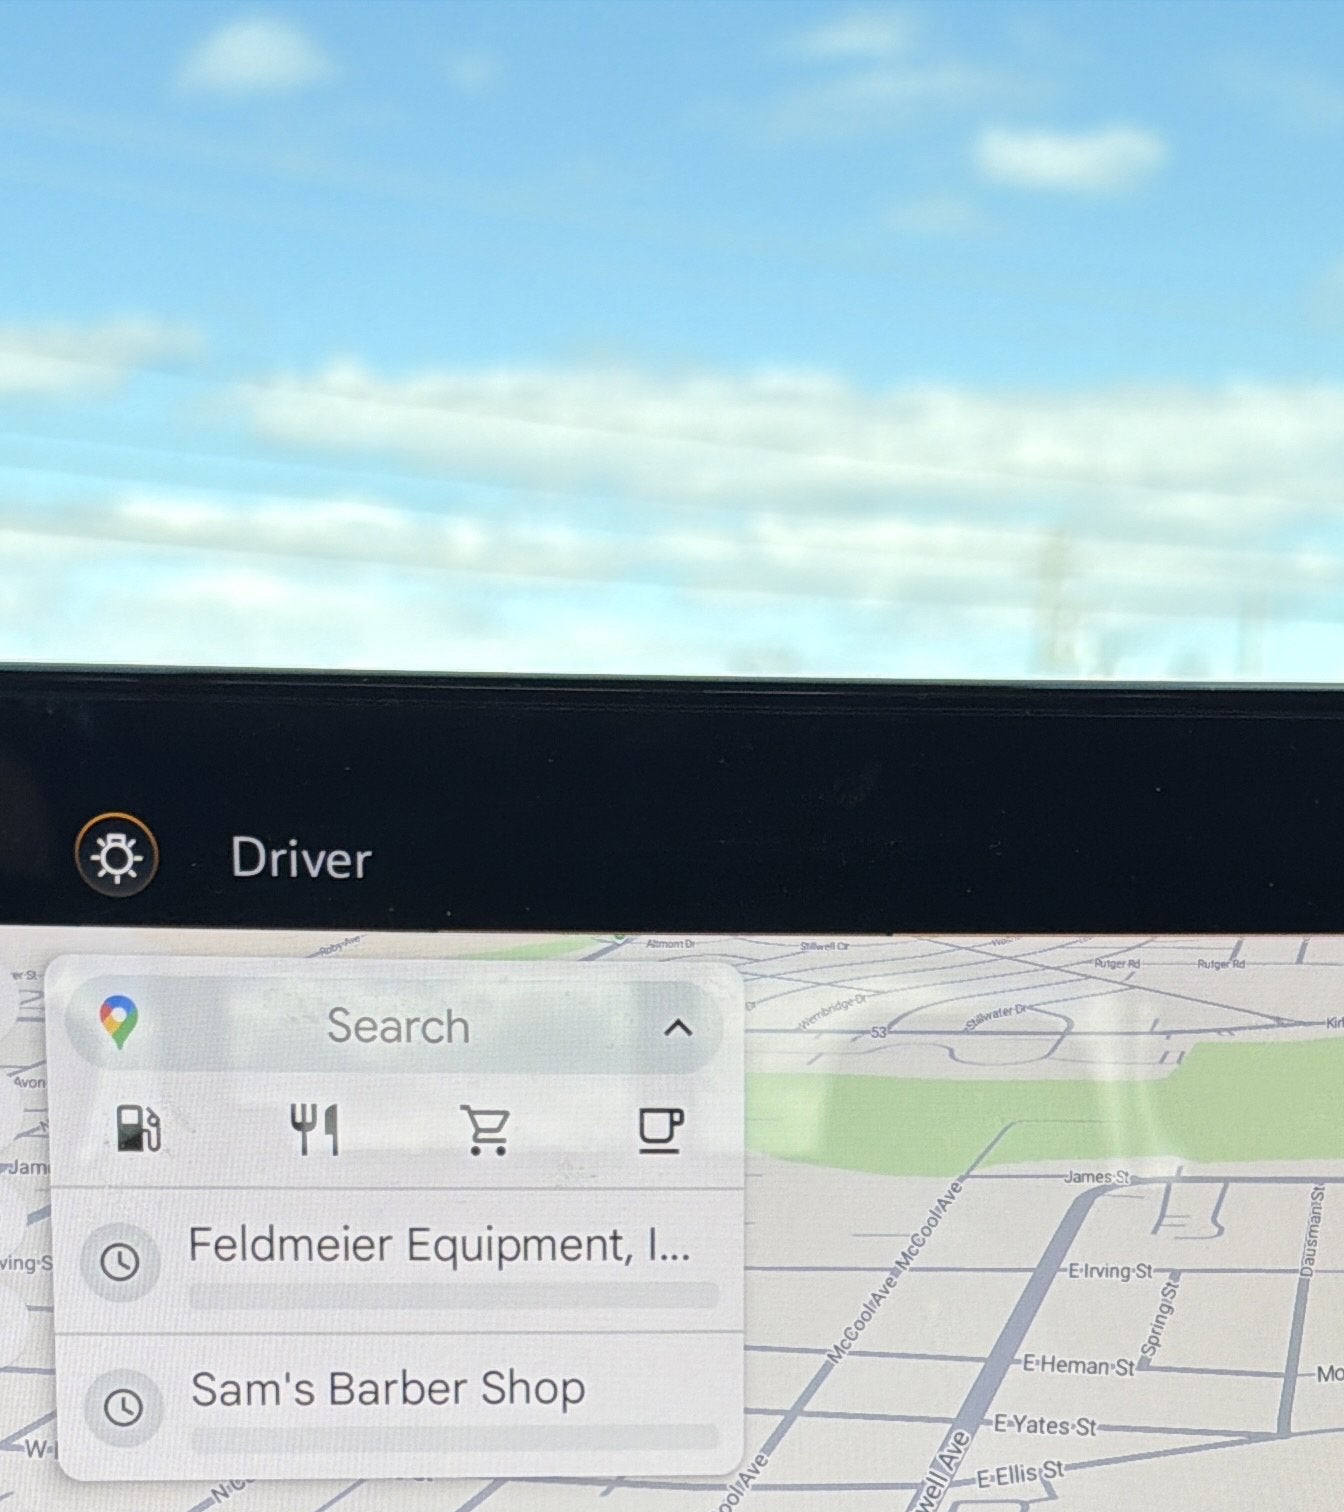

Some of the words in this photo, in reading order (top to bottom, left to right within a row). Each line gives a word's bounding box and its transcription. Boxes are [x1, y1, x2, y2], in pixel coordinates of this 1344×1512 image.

[231, 835, 373, 879] Driver
[1094, 958, 1126, 971] Rutger
[1127, 958, 1141, 968] Rd
[1197, 958, 1230, 971] Rutger
[1232, 958, 1246, 969] Rd
[327, 1006, 470, 1044] Search
[965, 1007, 1013, 1032] Stillwater
[1014, 1003, 1028, 1015] Dr
[871, 1026, 888, 1038] 53
[8, 1160, 51, 1175] Jam
[1063, 1169, 1112, 1184] James
[1115, 1169, 1130, 1184] St
[1311, 1184, 1326, 1202] St
[894, 1208, 943, 1271] McCool
[936, 1181, 963, 1212] Ave
[1299, 1203, 1324, 1277] Dausman
[189, 1224, 393, 1263] Feldmeier
[408, 1225, 634, 1272] Equipment,
[1069, 1263, 1080, 1278] E
[1084, 1262, 1130, 1283] Irving
[1135, 1264, 1152, 1279] St
[827, 1299, 877, 1365] McCool
[871, 1272, 898, 1307] Ave
[1140, 1299, 1176, 1358] Spring
[1161, 1280, 1181, 1300] St
[1023, 1354, 1035, 1371] E
[1041, 1355, 1109, 1375] Heman
[1116, 1358, 1135, 1376] St
[191, 1370, 316, 1406] Sam's
[329, 1368, 469, 1405] Barber
[481, 1368, 586, 1414] Shop
[994, 1414, 1007, 1432] E
[1013, 1415, 1071, 1435] Yates
[1076, 1417, 1097, 1437] St
[25, 1439, 47, 1459] W
[938, 1429, 972, 1474] Ave
[736, 1452, 769, 1489] Ave
[977, 1469, 990, 1488] E
[995, 1465, 1040, 1486] Ellis
[1042, 1460, 1065, 1480] St
